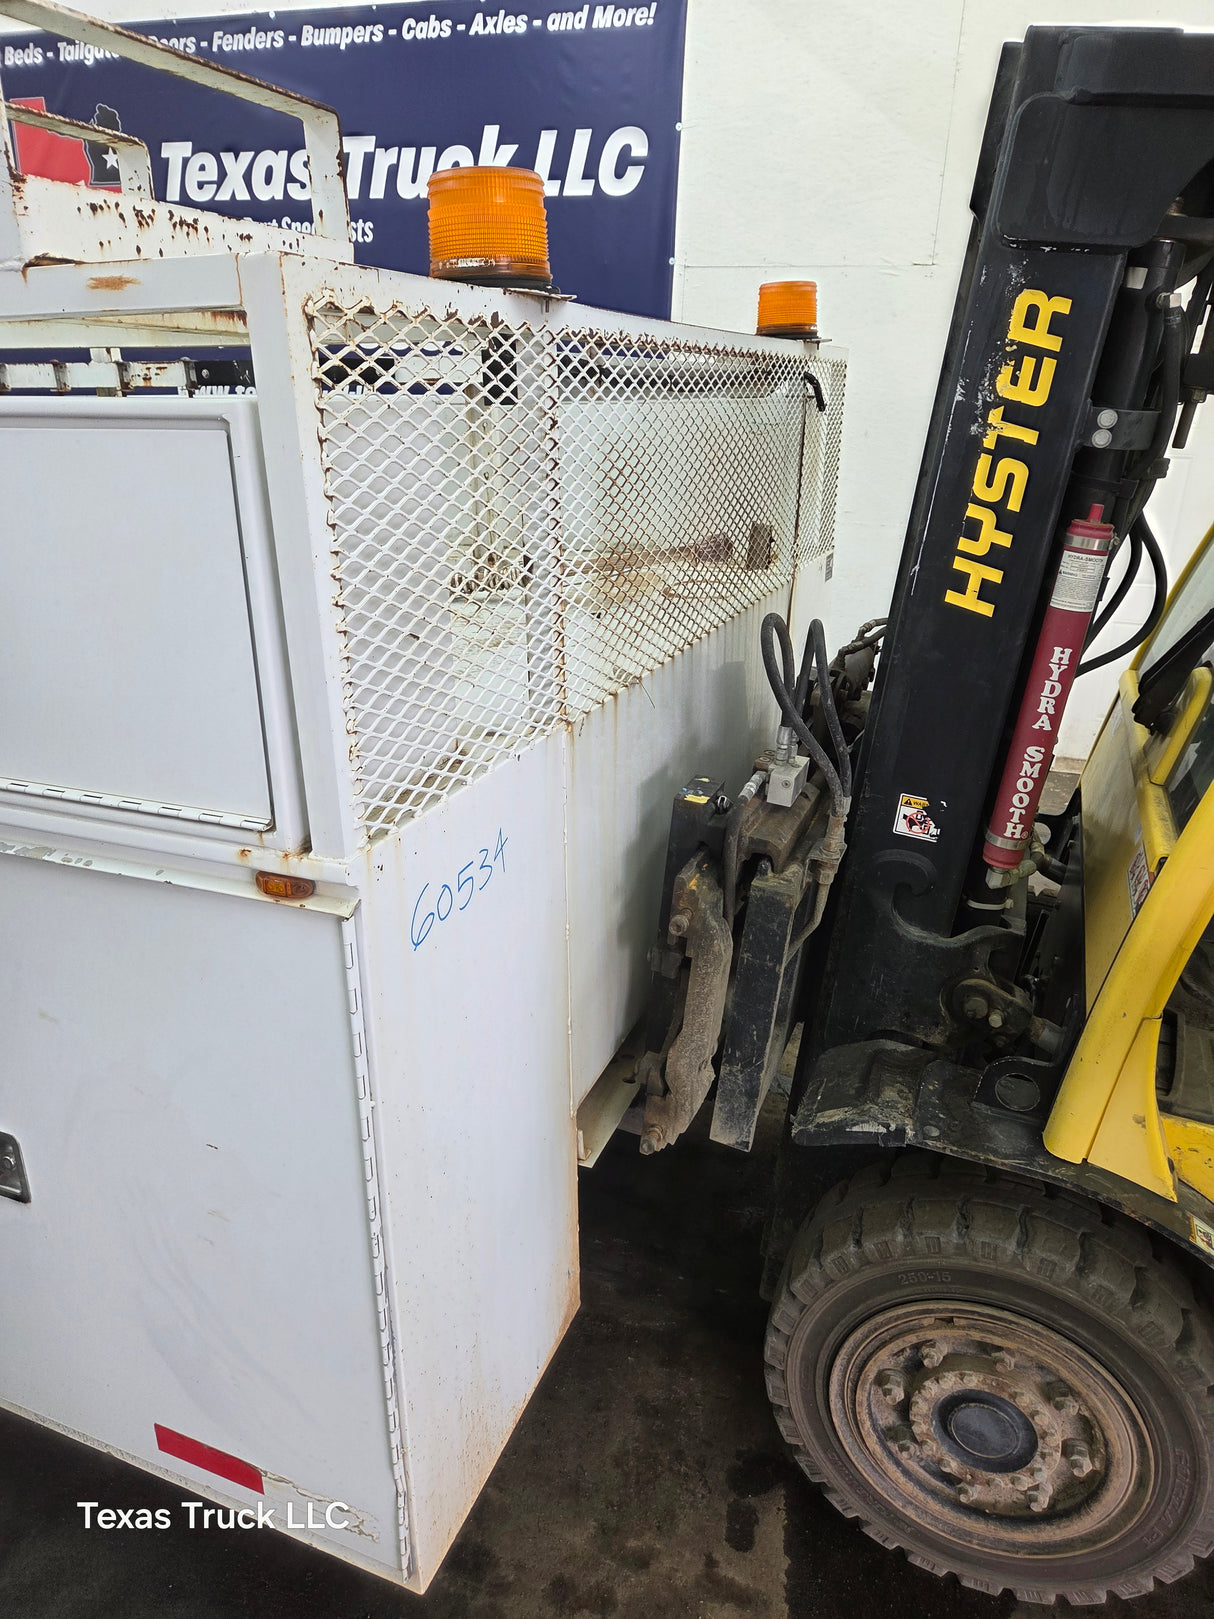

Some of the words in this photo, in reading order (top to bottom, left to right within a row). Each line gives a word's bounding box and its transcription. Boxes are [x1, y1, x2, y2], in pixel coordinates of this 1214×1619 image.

[4, 43, 42, 65] Beds
[212, 27, 284, 52] Fenders
[301, 24, 384, 50] Bumpers
[401, 14, 452, 40] Cabs
[468, 9, 528, 36] Axles
[546, 4, 590, 32] and
[592, 1, 658, 29] More!
[160, 141, 312, 201] Texas
[532, 126, 649, 197] LLC
[944, 288, 1073, 618] HYSTER
[1032, 646, 1073, 731] HYDRA
[411, 827, 508, 951] 60534
